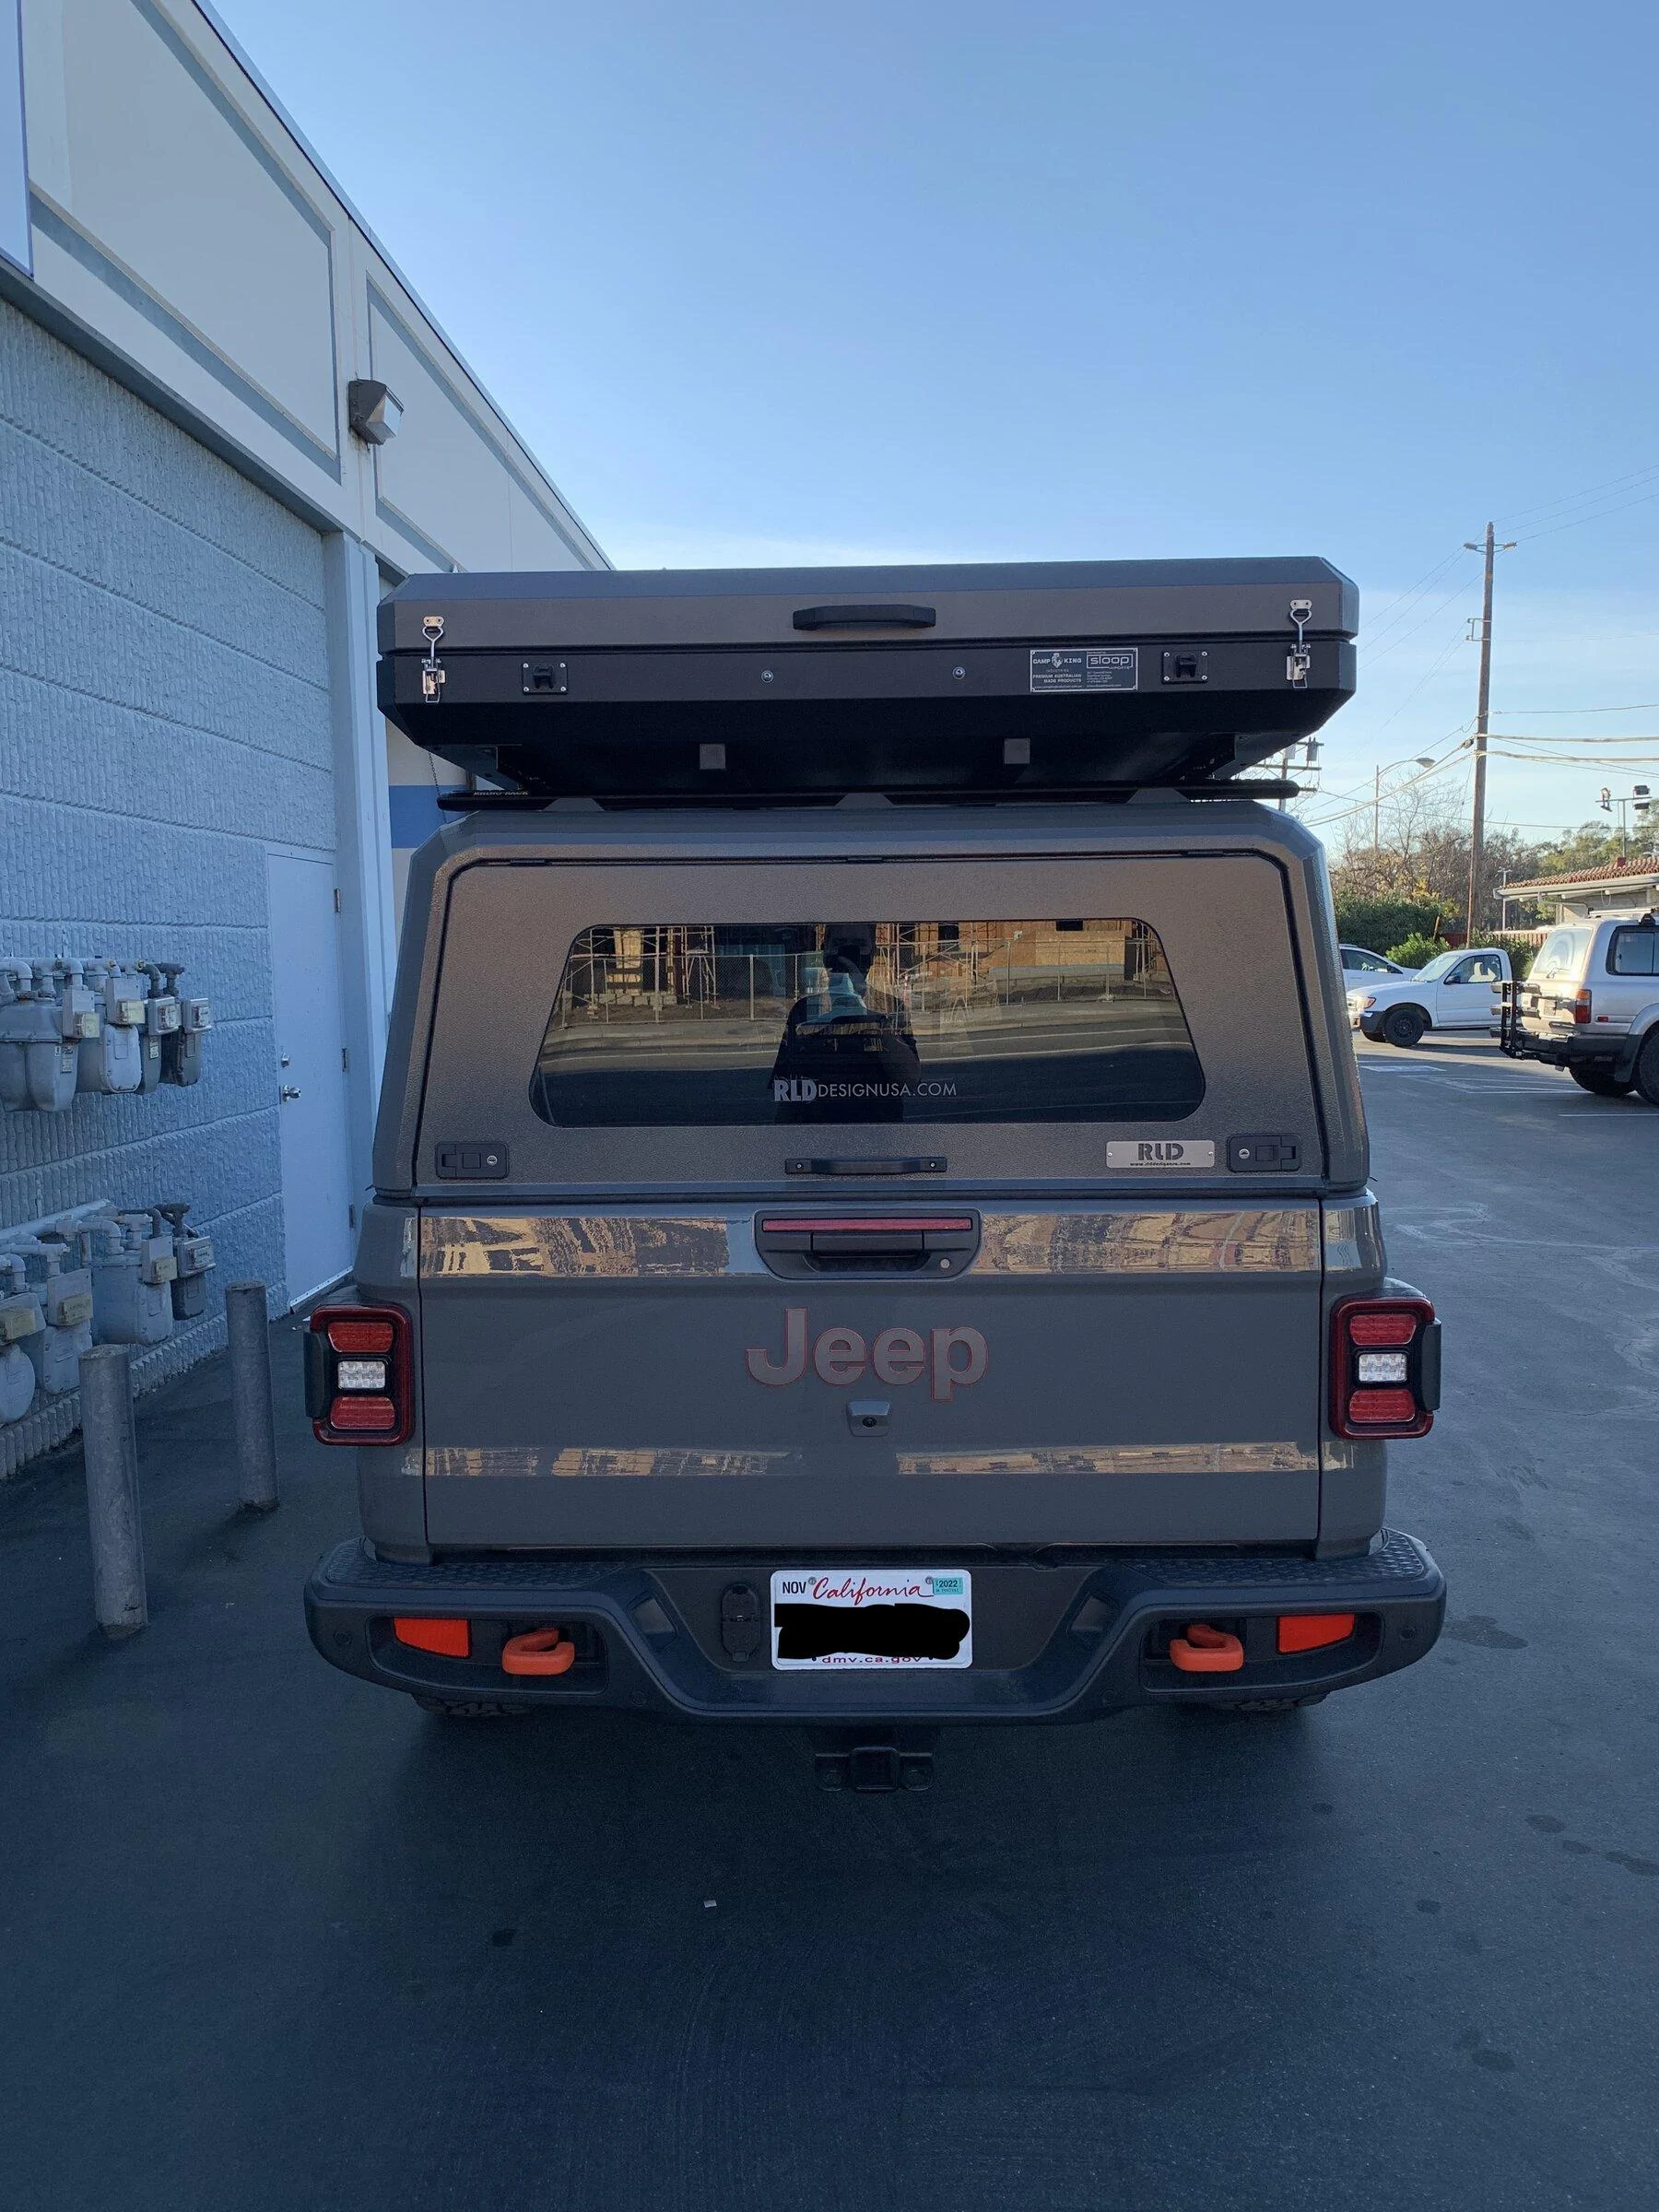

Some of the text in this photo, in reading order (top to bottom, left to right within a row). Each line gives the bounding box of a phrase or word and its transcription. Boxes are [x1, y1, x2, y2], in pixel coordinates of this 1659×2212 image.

[1090, 655, 1130, 666] sloop
[1138, 1143, 1184, 1161] RLD
[745, 1307, 989, 1401] Jeep
[782, 1581, 806, 1594] NOV
[939, 1580, 958, 1588] 2022
[812, 1577, 935, 1606] California
[821, 1656, 921, 1665] dmv.ca.gov
